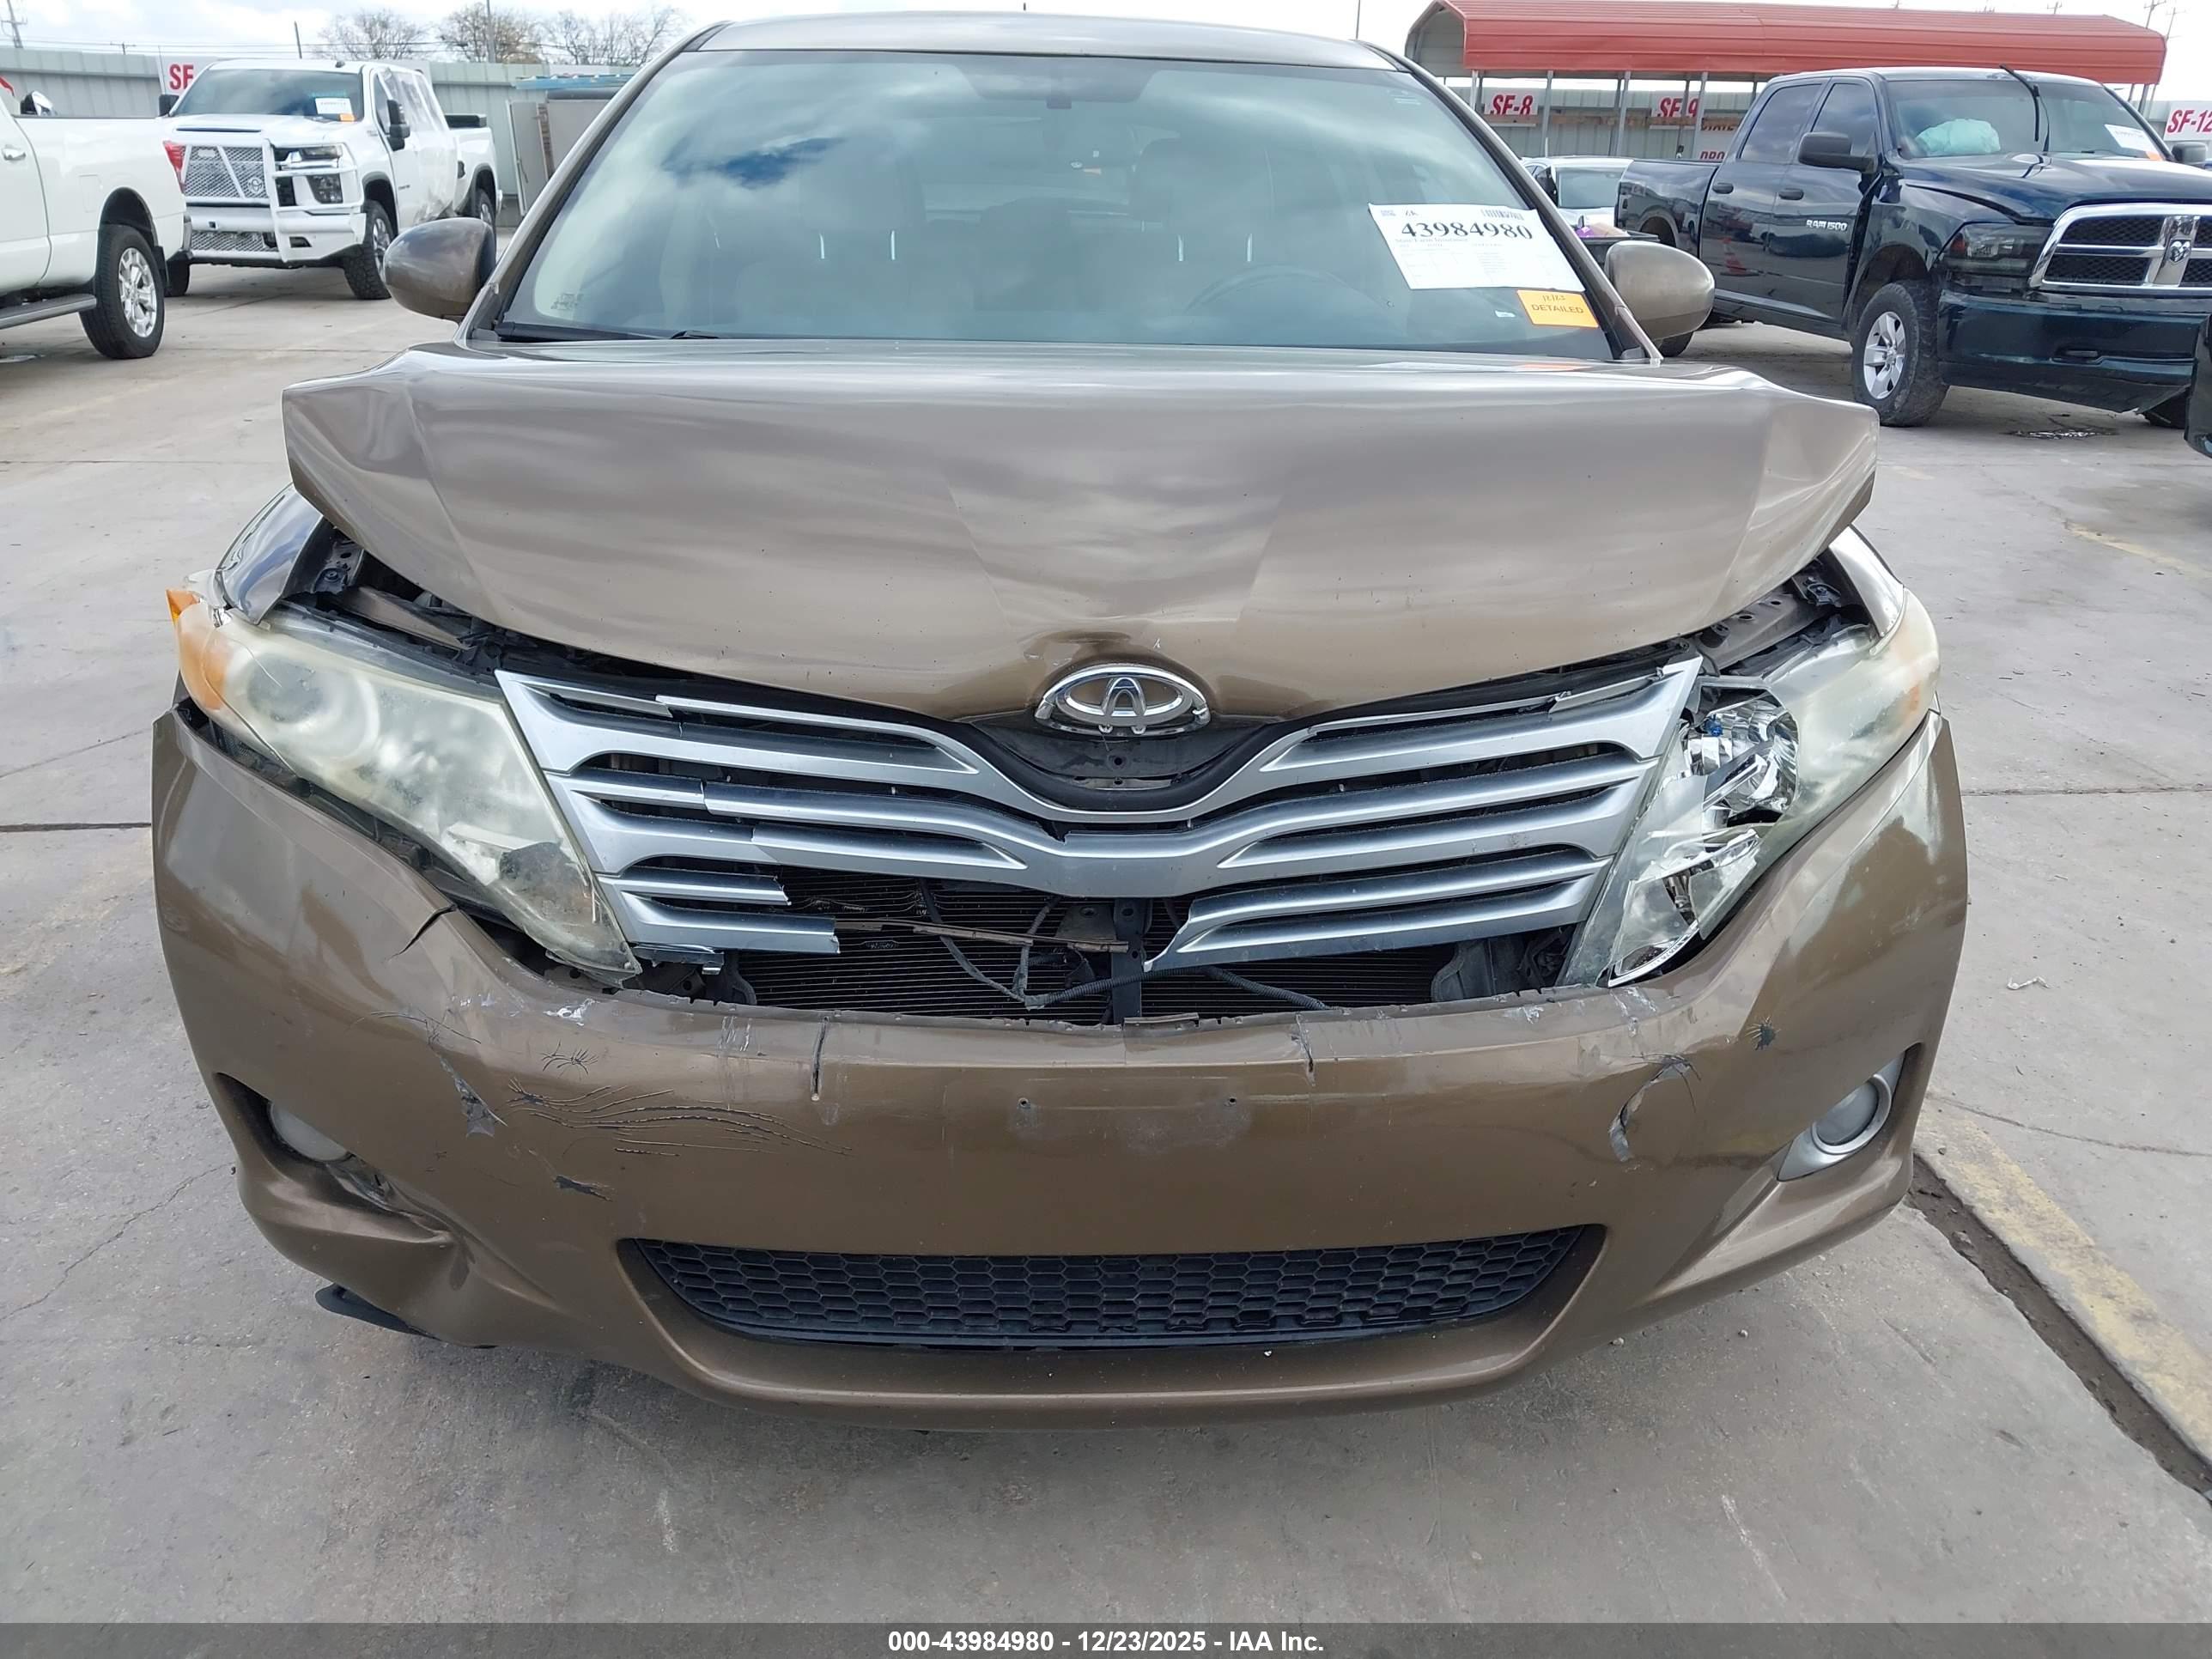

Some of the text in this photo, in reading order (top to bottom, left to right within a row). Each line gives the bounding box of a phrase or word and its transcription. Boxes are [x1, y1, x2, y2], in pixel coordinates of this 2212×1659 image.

[1491, 94, 1534, 114] SF-8
[1401, 222, 1533, 240] 43984980
[1806, 219, 1847, 231] RAM 1500
[1531, 304, 1584, 314] DETAILED
